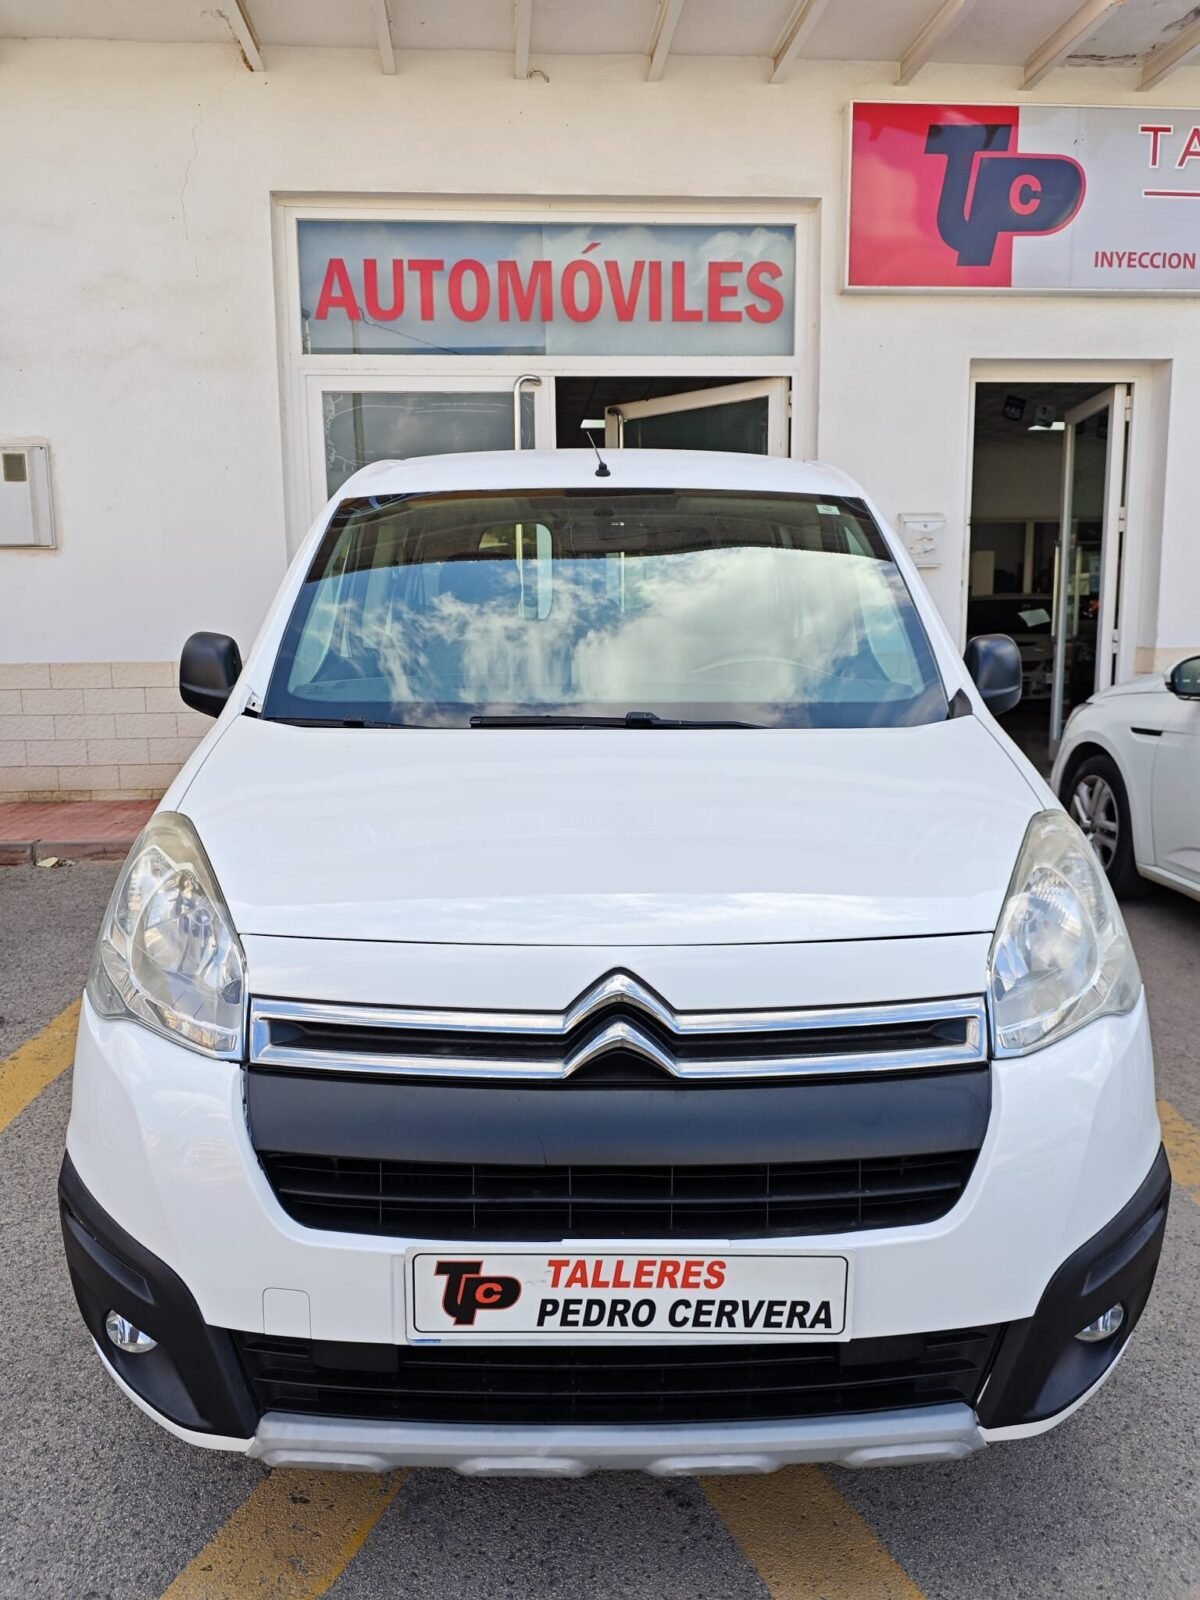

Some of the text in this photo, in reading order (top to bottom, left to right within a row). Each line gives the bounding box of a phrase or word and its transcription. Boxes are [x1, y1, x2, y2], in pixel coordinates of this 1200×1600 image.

[1094, 251, 1197, 269] INYECCION
[314, 242, 785, 324] AUTOMÓVILES
[547, 1259, 727, 1290] TALLERES
[536, 1298, 833, 1329] PEDRO CERVERA
